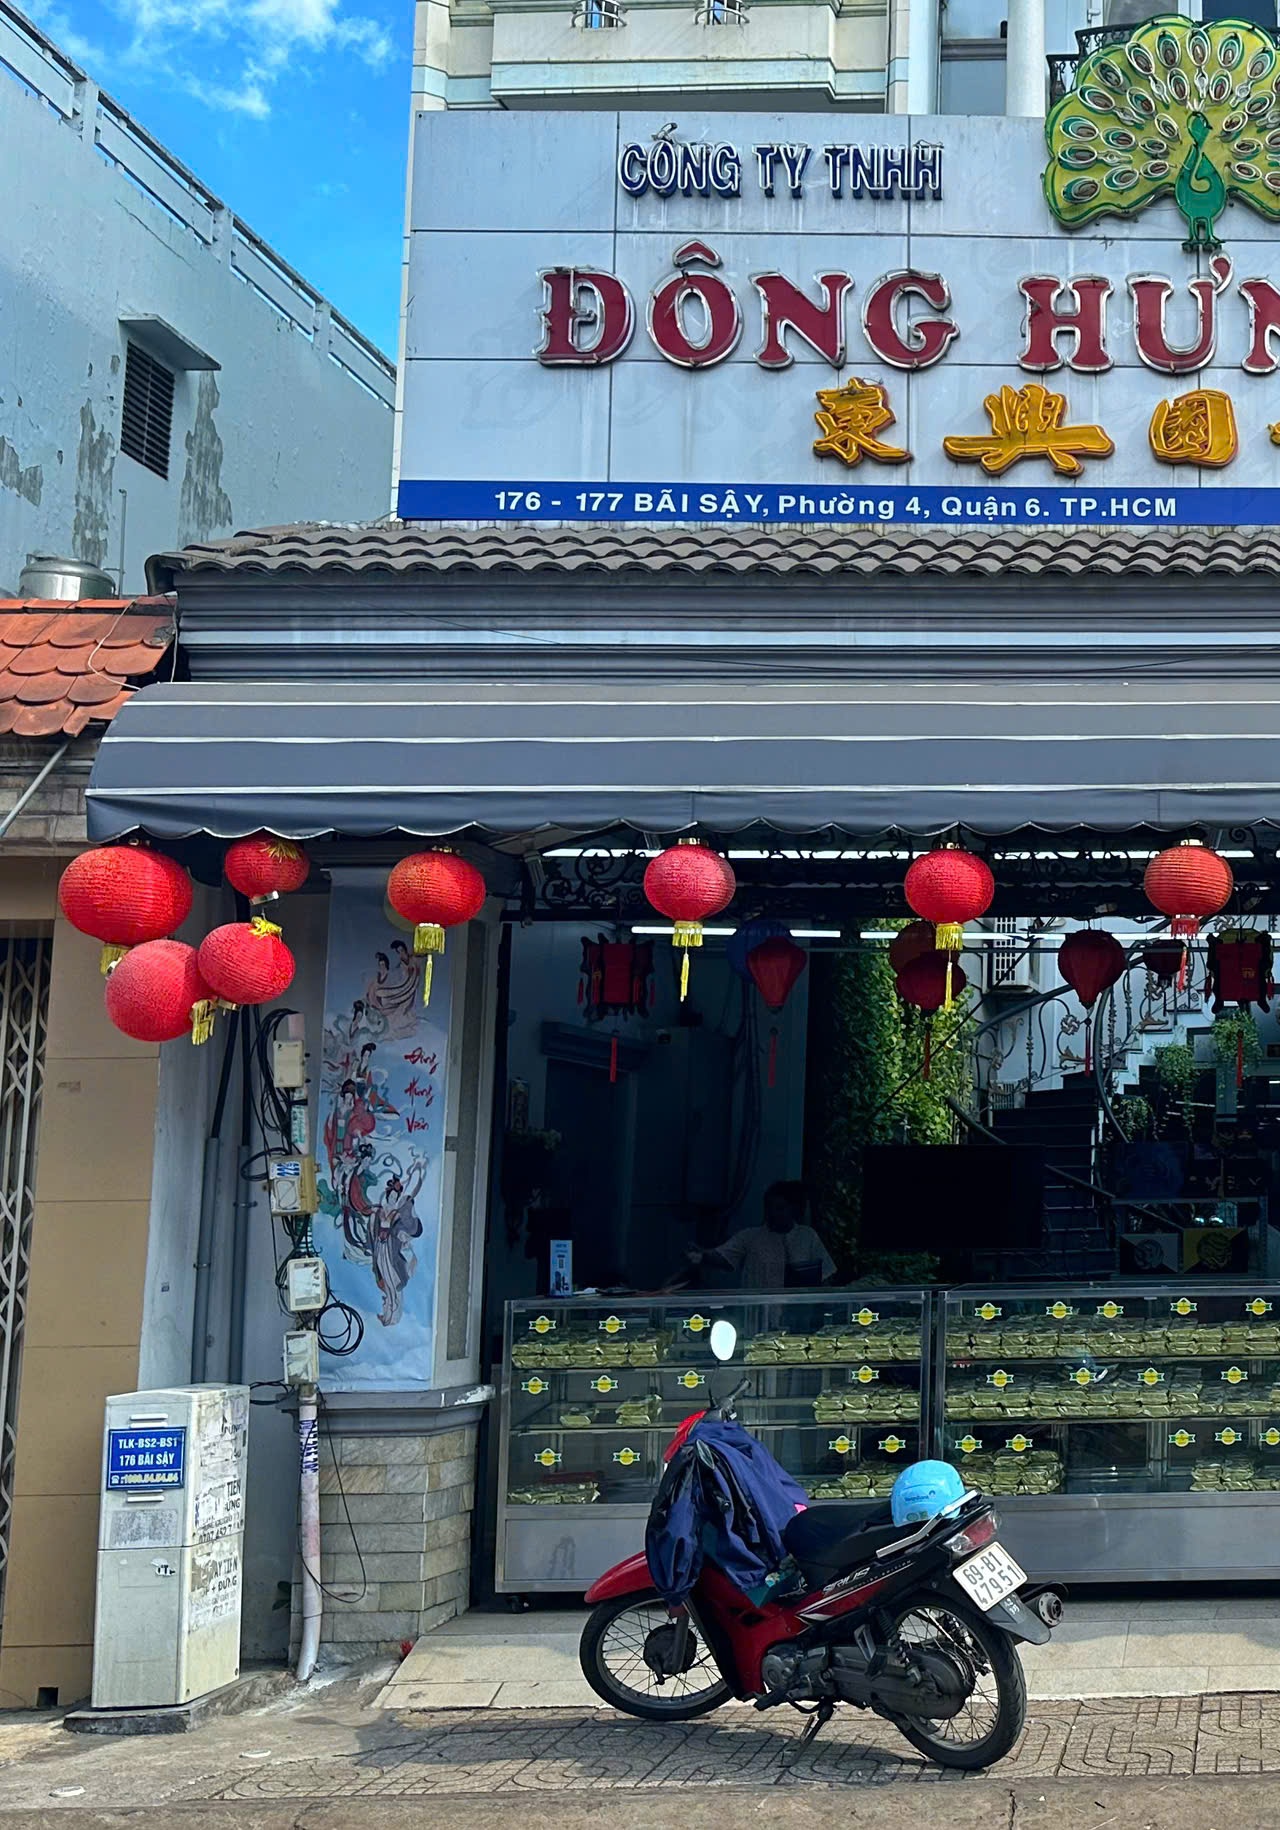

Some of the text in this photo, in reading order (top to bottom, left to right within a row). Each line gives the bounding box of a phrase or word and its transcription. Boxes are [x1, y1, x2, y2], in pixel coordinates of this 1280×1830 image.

[752, 142, 813, 198] TY
[824, 140, 943, 199] TNHH
[535, 237, 960, 371] ĐÔNG
[494, 491, 541, 511] 176
[576, 492, 624, 513] 177
[634, 489, 688, 513] BÃI
[699, 489, 769, 519] SẬY,
[779, 493, 895, 520] Phường
[905, 496, 930, 518] 4,
[941, 496, 1016, 521] Quận
[1025, 497, 1049, 518] 6.
[1060, 497, 1177, 518] TP.HCM
[119, 1437, 177, 1449] TLK-BS2-BS1
[119, 1451, 174, 1467] 176 BÃI SẬY
[962, 1551, 1002, 1586] 69-B1
[973, 1565, 1022, 1605] 479.51
